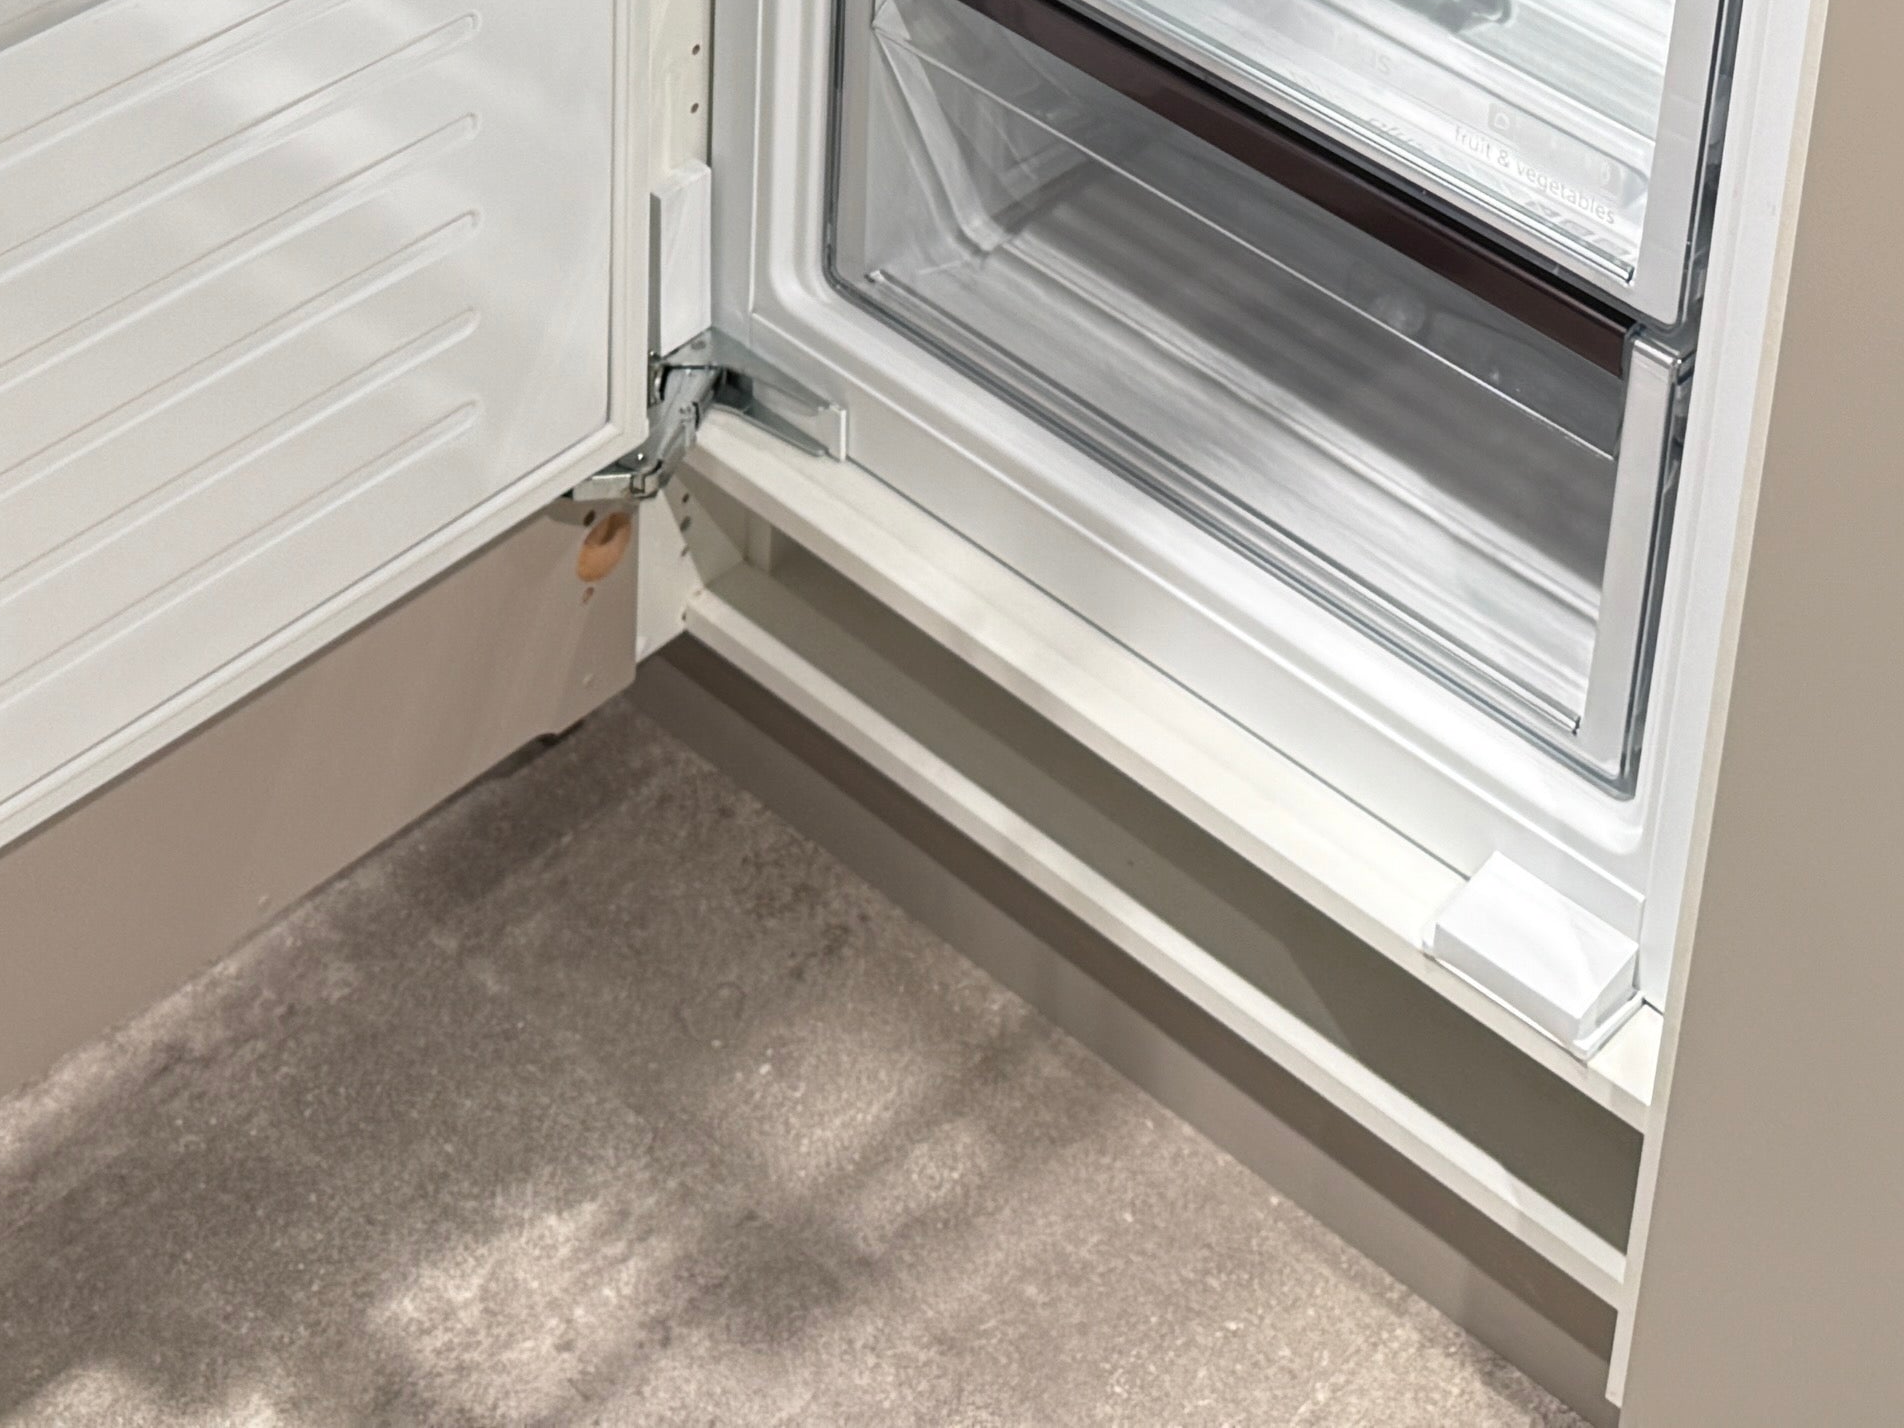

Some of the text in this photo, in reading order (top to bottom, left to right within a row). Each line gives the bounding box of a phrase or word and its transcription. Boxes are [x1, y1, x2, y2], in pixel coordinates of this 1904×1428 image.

[1454, 123, 1618, 226] fruit & vegetables
